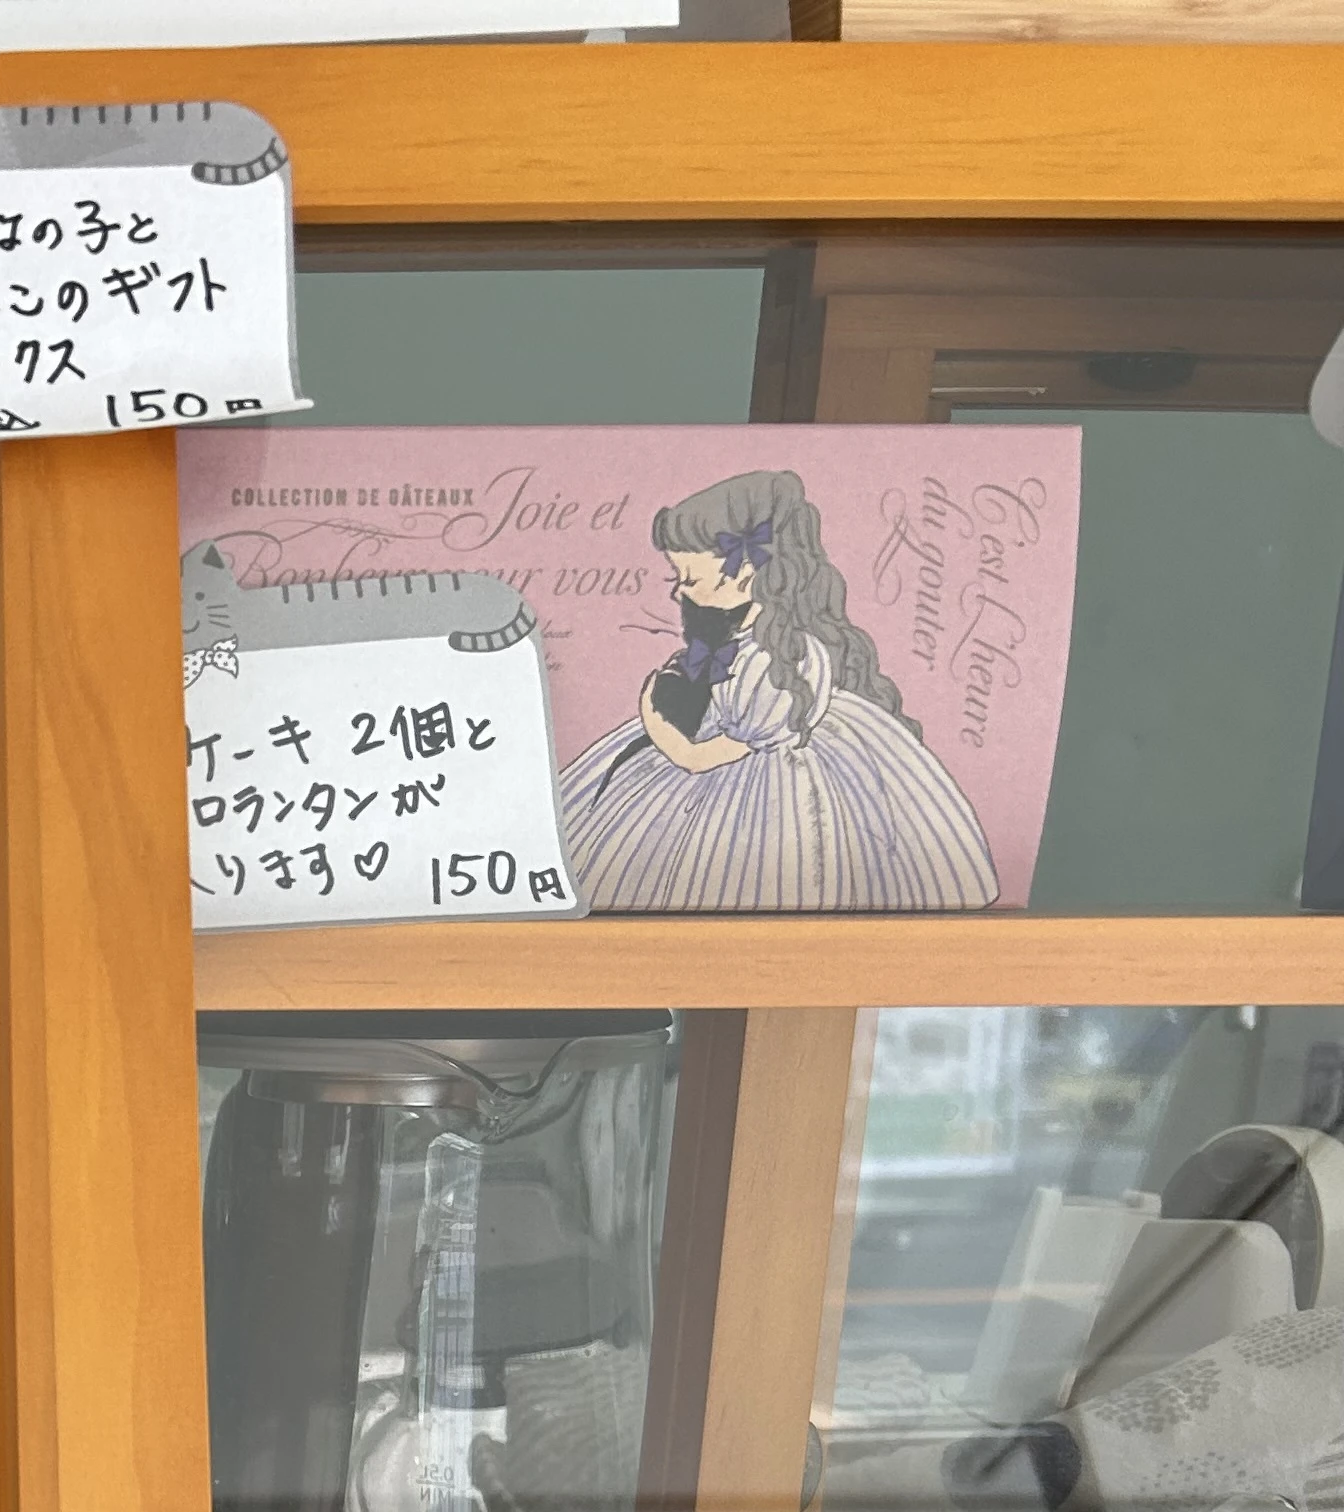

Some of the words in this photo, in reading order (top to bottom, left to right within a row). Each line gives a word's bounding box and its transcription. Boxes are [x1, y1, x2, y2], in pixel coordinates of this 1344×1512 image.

[230, 486, 348, 507] COLLECTION
[356, 487, 380, 507] DE
[388, 483, 475, 507] GÂTEAUX
[441, 466, 579, 552] Joie
[590, 493, 631, 532] et
[922, 476, 974, 540] du
[553, 566, 649, 597] vous
[430, 849, 568, 906] 150円
